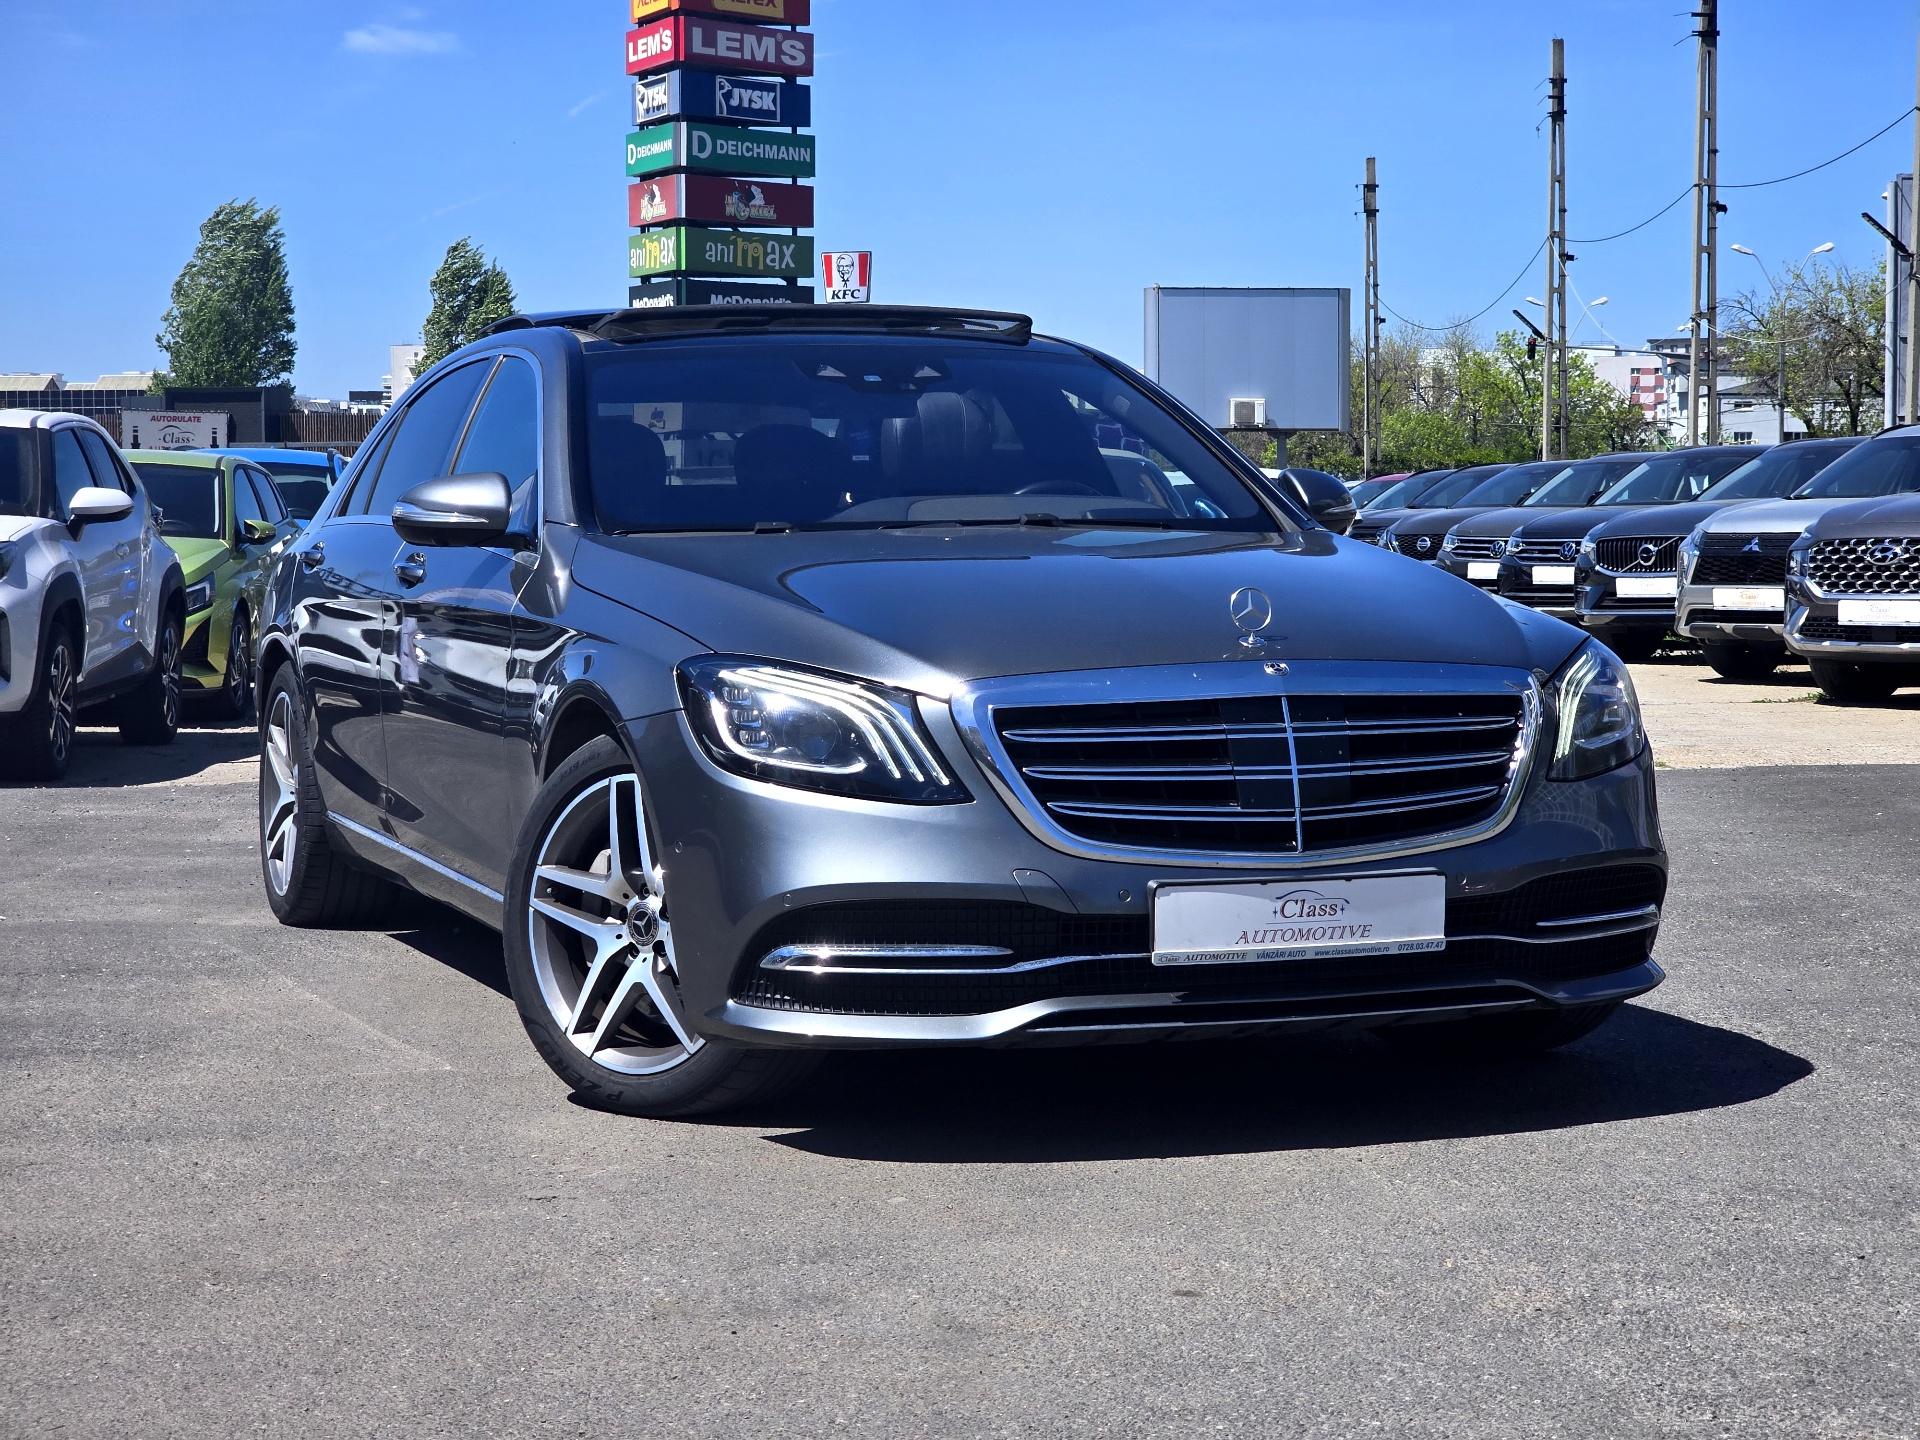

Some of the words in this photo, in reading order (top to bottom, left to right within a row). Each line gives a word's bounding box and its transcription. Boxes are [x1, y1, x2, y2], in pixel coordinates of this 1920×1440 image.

[628, 27, 673, 63] LEM'S
[692, 27, 806, 66] LEM'S
[729, 88, 776, 111] JYSK
[636, 139, 673, 159] DEICHMANN
[716, 139, 811, 163] DEICHMANN
[630, 235, 676, 269] animax
[705, 235, 796, 270] animax
[831, 288, 861, 300] KFC
[150, 415, 202, 424] AUTORULATE
[162, 432, 191, 444] Class
[1280, 899, 1338, 919] Class
[1235, 924, 1373, 945] AUTOMOTIVE
[1183, 952, 1248, 962] AUTOMOTIVE
[1287, 950, 1307, 958] AUTO
[1314, 946, 1390, 957] www.classautomotive.ro
[1397, 941, 1444, 952] 0728.03.47.47
